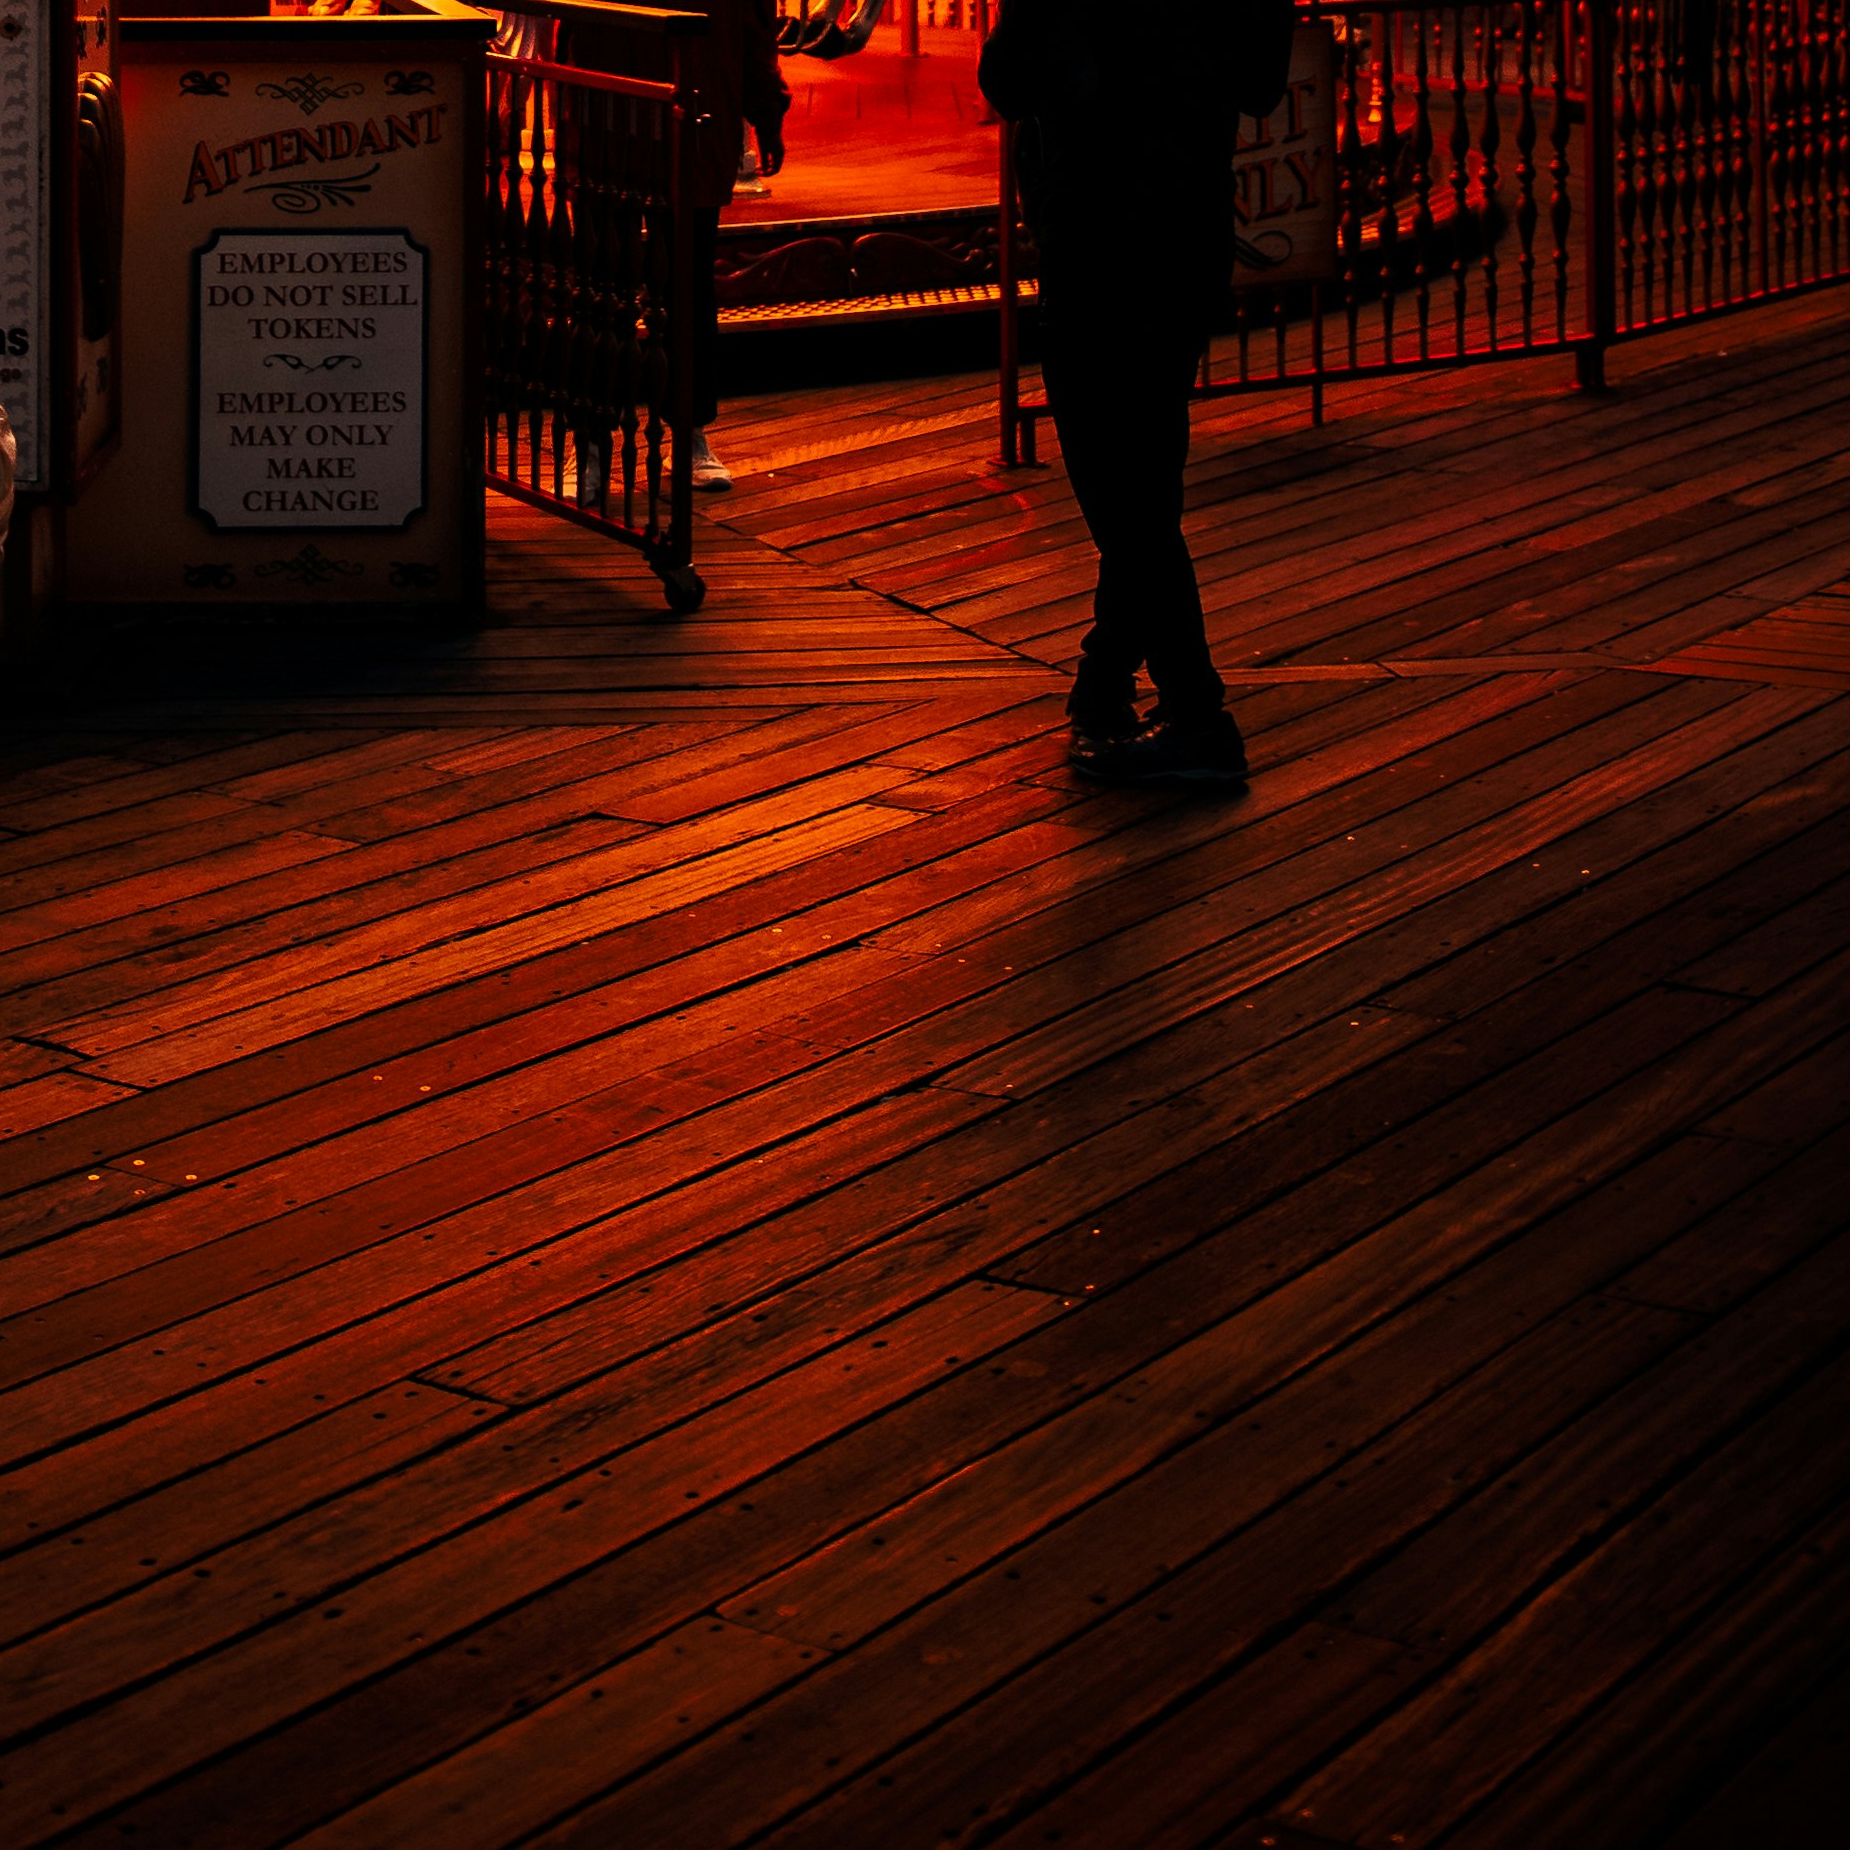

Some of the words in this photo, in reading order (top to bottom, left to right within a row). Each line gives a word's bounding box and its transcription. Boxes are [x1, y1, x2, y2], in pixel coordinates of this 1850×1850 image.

[182, 103, 449, 204] ATTENDANT
[1234, 142, 1330, 226] NLY
[217, 252, 409, 275] EMPLOYEES
[207, 284, 254, 307] DO
[263, 284, 334, 307] NOT
[341, 283, 419, 307] SELL
[248, 317, 377, 340] TOKENS
[216, 391, 408, 415] EMPLOYEES
[229, 424, 298, 448] MAY
[305, 424, 394, 448] ONLY
[266, 457, 356, 480] MAKE
[242, 489, 380, 514] CHANGE
